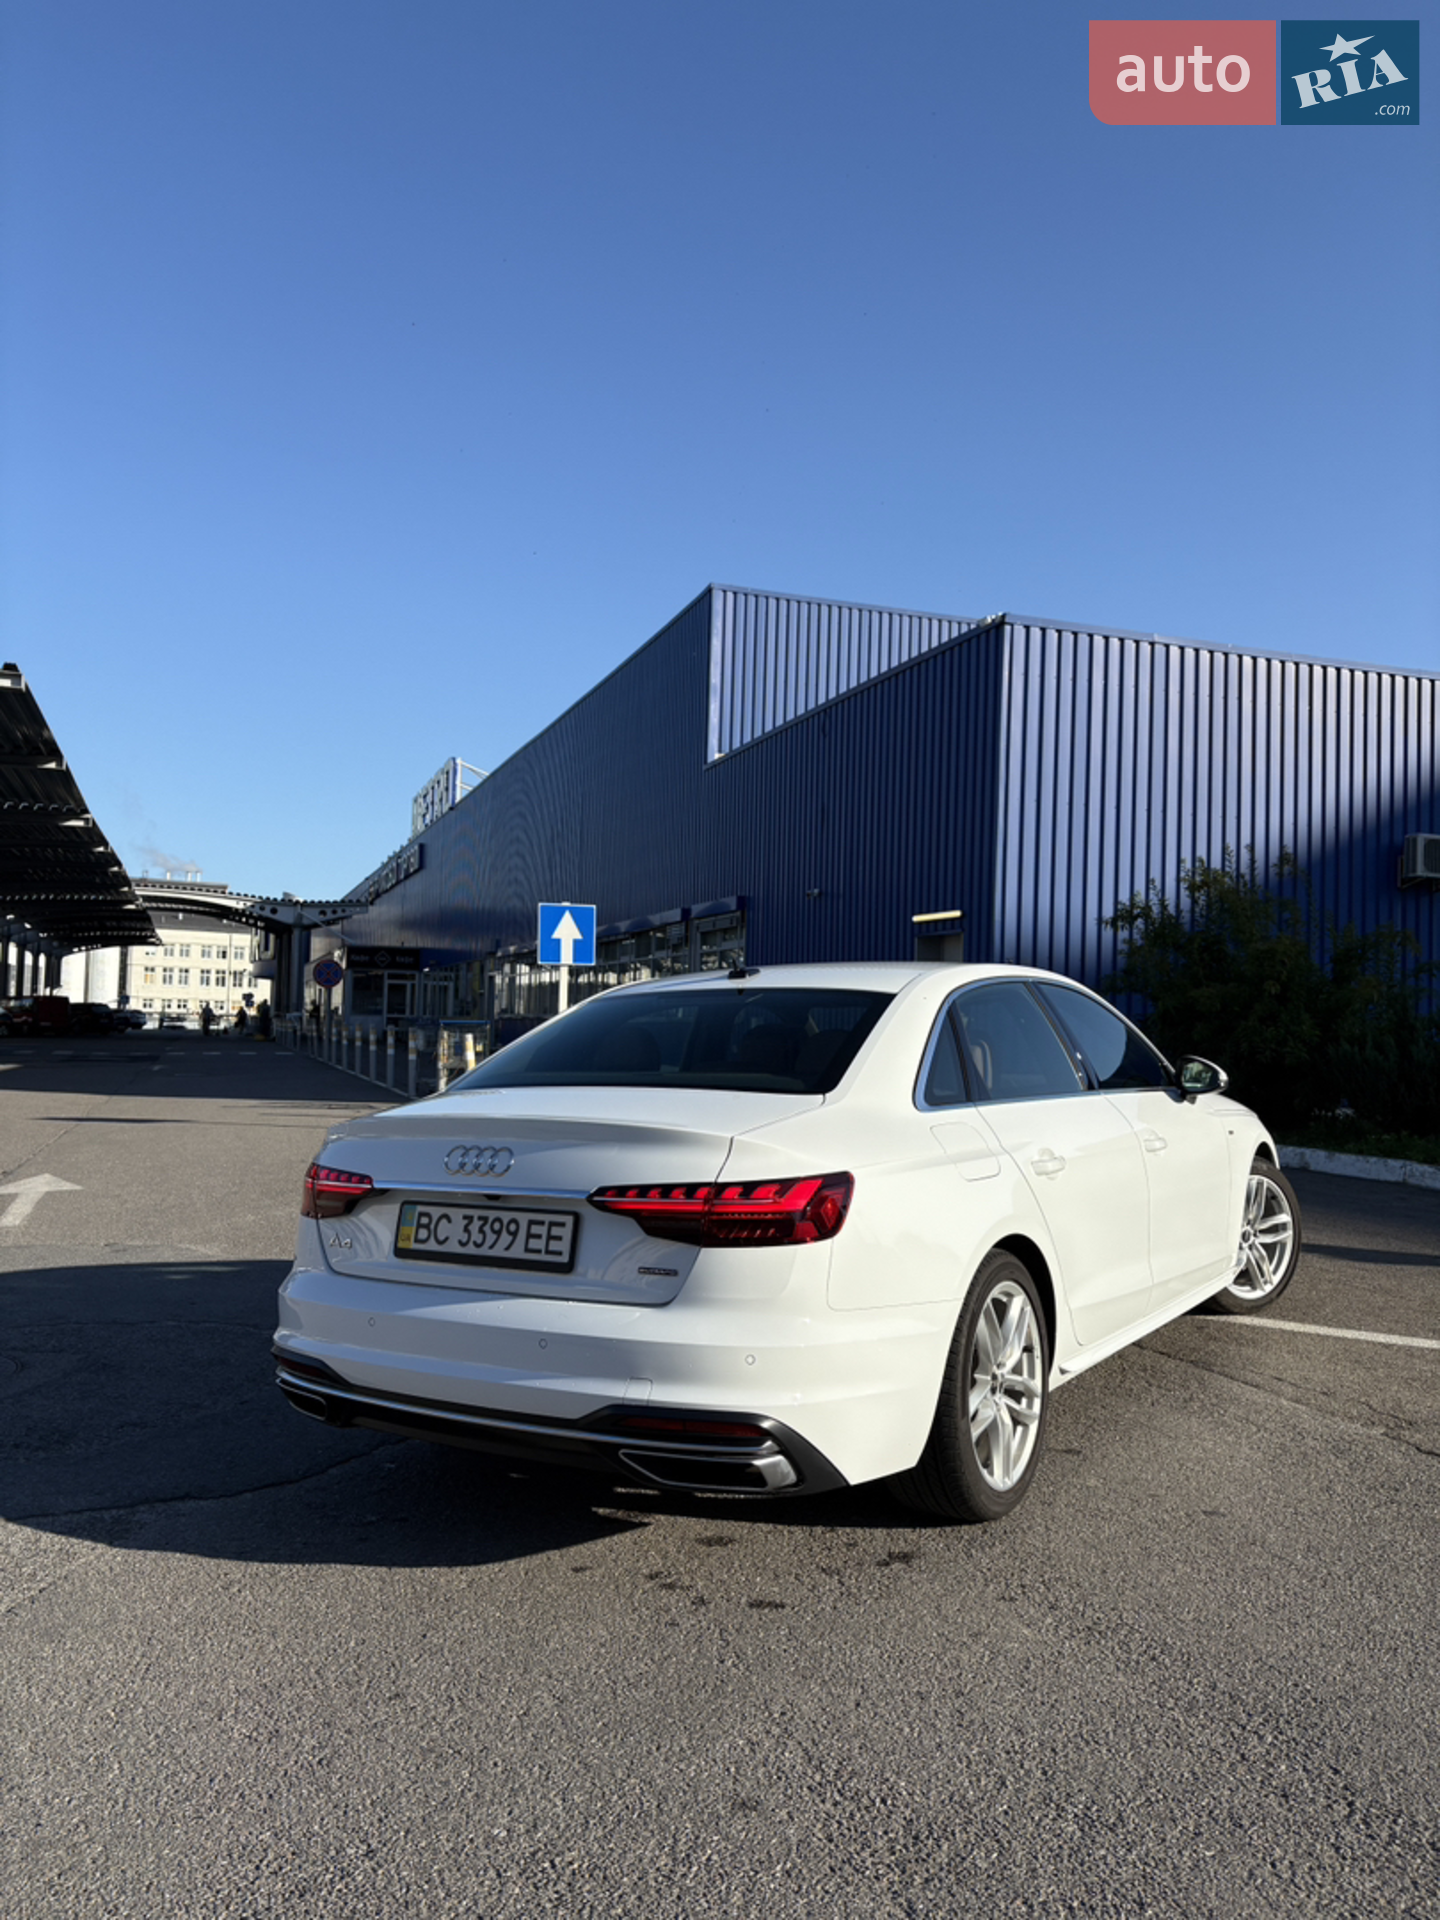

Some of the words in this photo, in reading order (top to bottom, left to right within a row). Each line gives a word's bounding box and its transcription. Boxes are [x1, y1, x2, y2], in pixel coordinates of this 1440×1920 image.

[329, 1231, 352, 1249] A4
[413, 1211, 453, 1245] BC
[458, 1214, 520, 1251] 3399
[524, 1219, 566, 1256] EE
